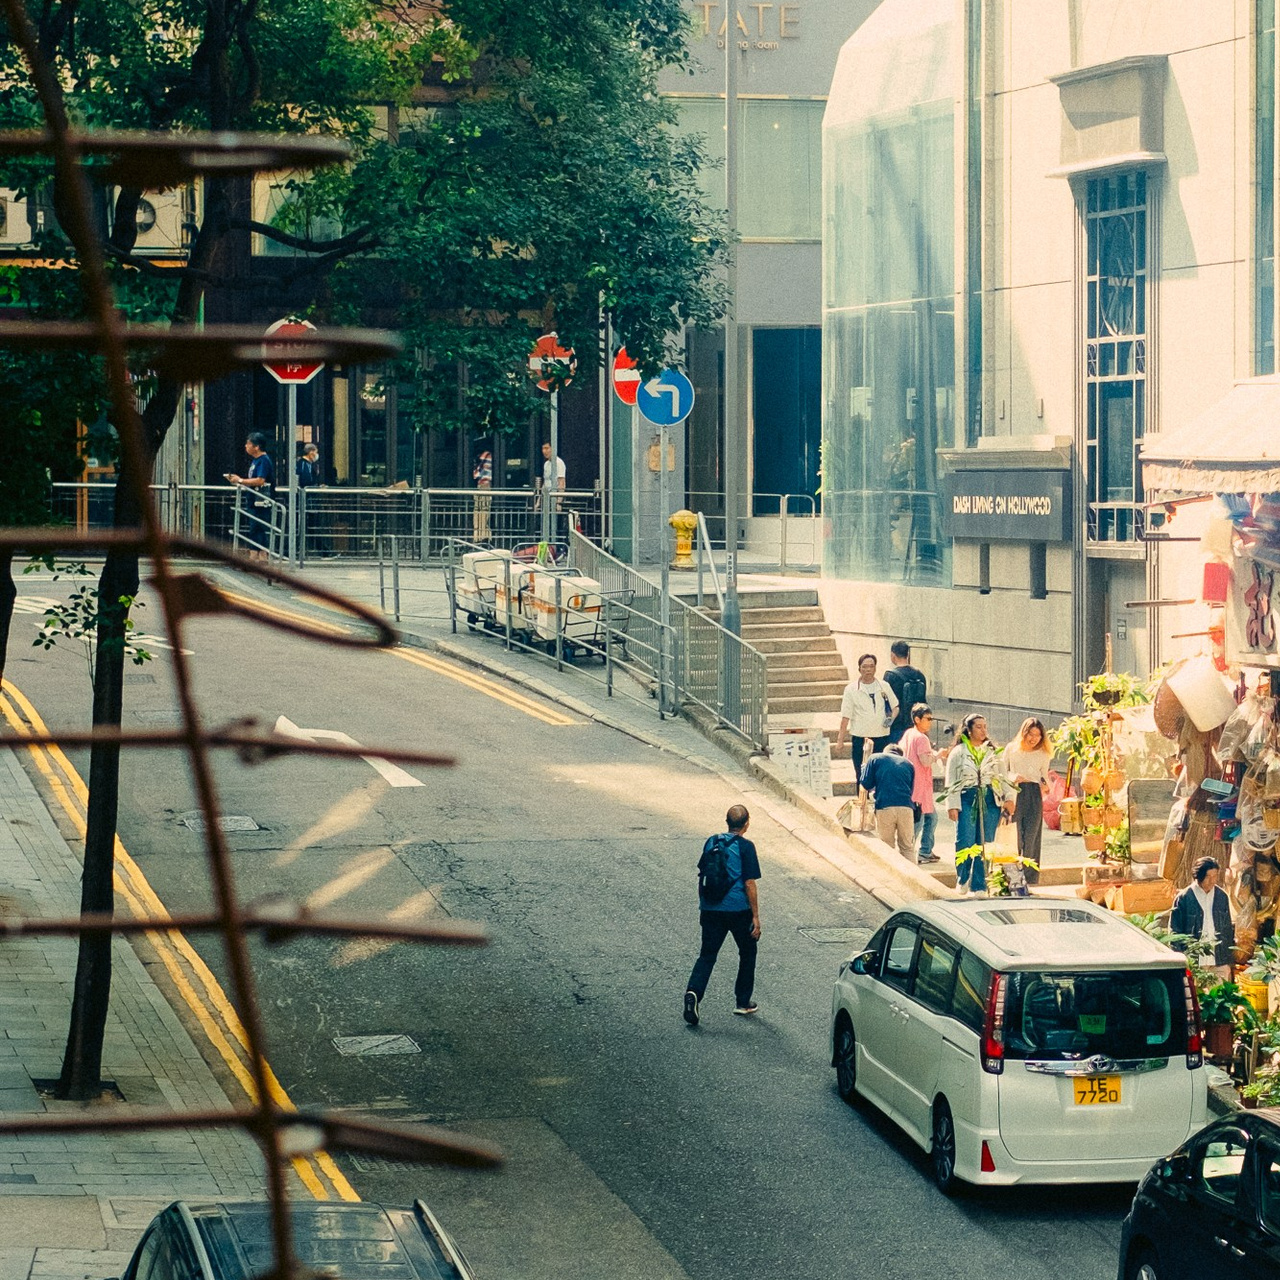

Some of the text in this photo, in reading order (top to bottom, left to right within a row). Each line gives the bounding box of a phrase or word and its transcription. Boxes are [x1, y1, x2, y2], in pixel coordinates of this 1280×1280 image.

[953, 496, 1051, 515] DASH LIVING ON HOLLYWOOD
[1087, 1078, 1107, 1091] TE
[1077, 1091, 1118, 1104] 7720
